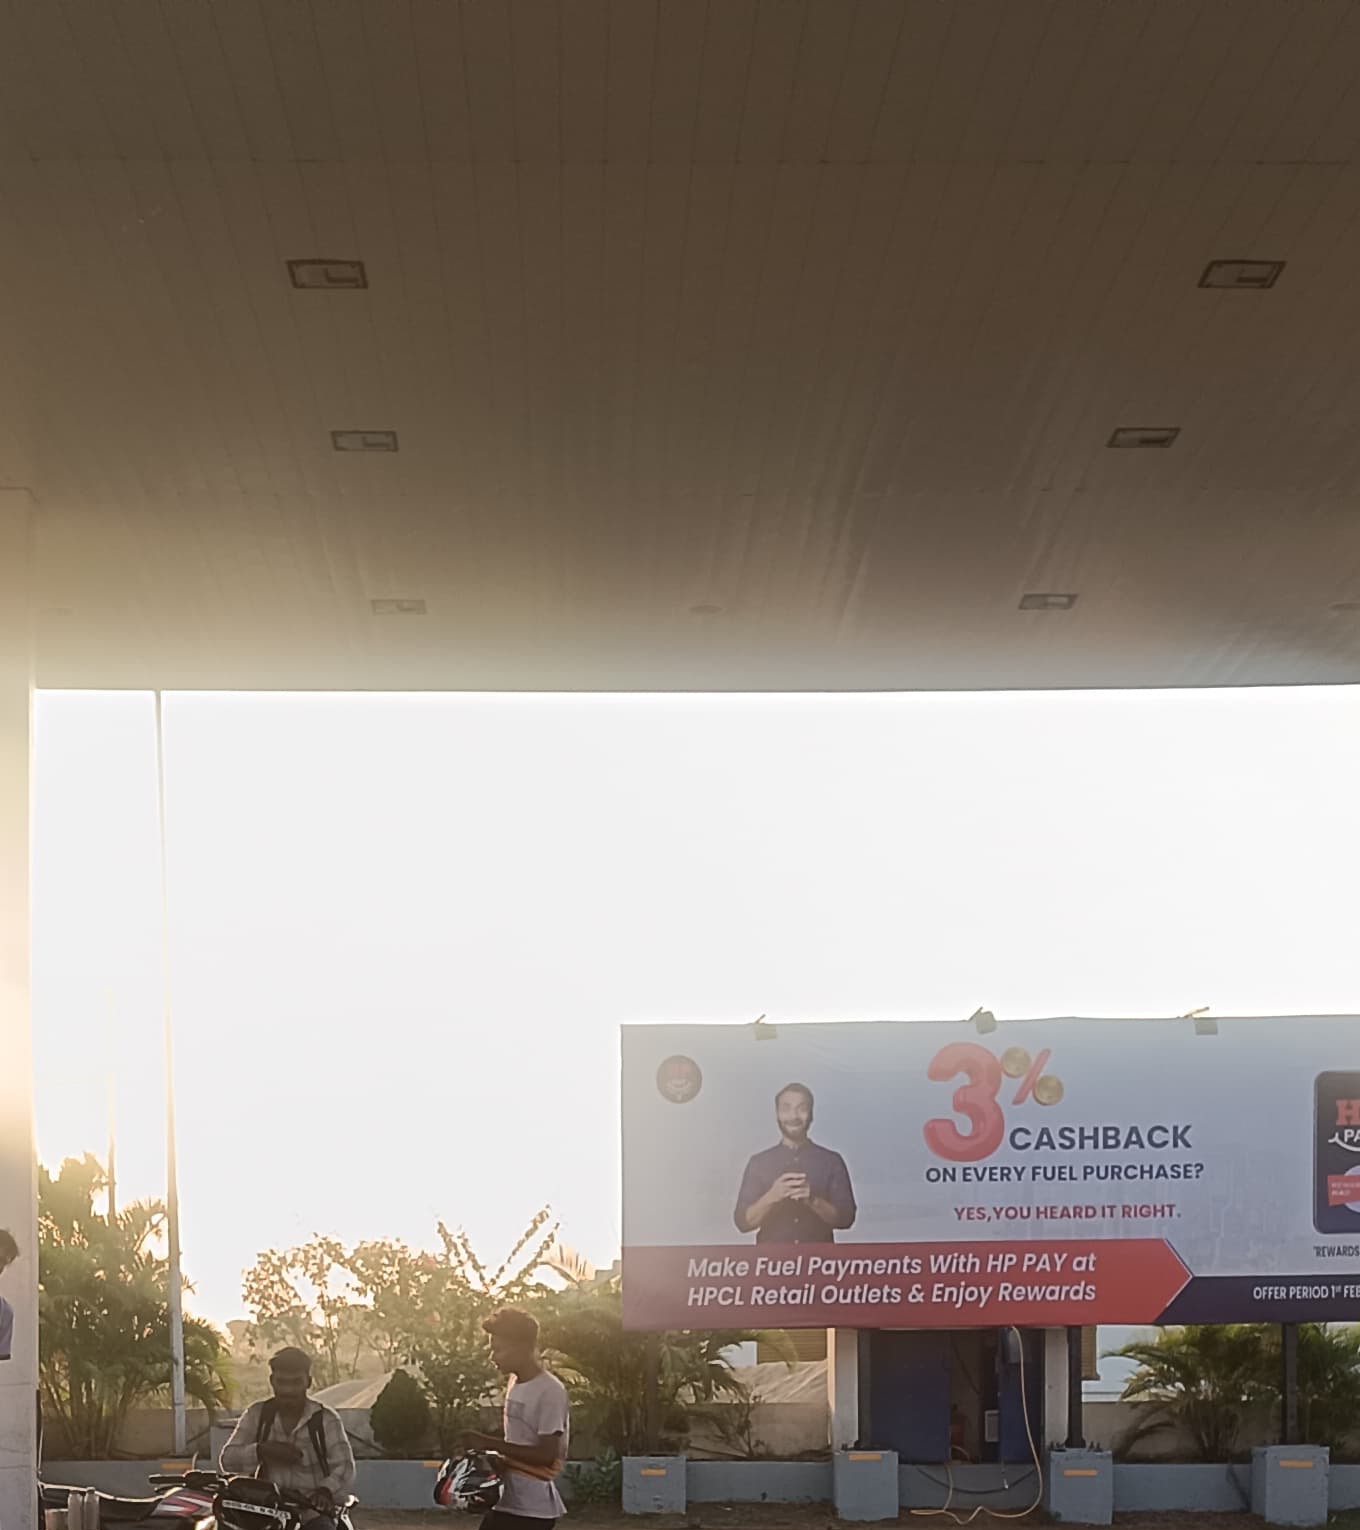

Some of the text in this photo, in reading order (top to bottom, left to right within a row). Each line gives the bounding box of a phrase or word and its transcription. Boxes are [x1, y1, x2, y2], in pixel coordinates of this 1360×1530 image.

[923, 1042, 1192, 1162] 3% CASHBACK
[926, 1163, 1204, 1183] ON EVERY FUEL PURCHASE?
[1036, 1206, 1096, 1220] HEARD
[1101, 1205, 1117, 1219] IT
[1121, 1204, 1182, 1219] RIGHT.
[687, 1253, 1096, 1281] Make Fuel Payments With HP PAY at
[688, 1281, 1096, 1308] HPCL Retail Outlets & Enjoy Rewards
[1253, 1286, 1287, 1300] OFFER
[1289, 1285, 1329, 1299] PERIOD
